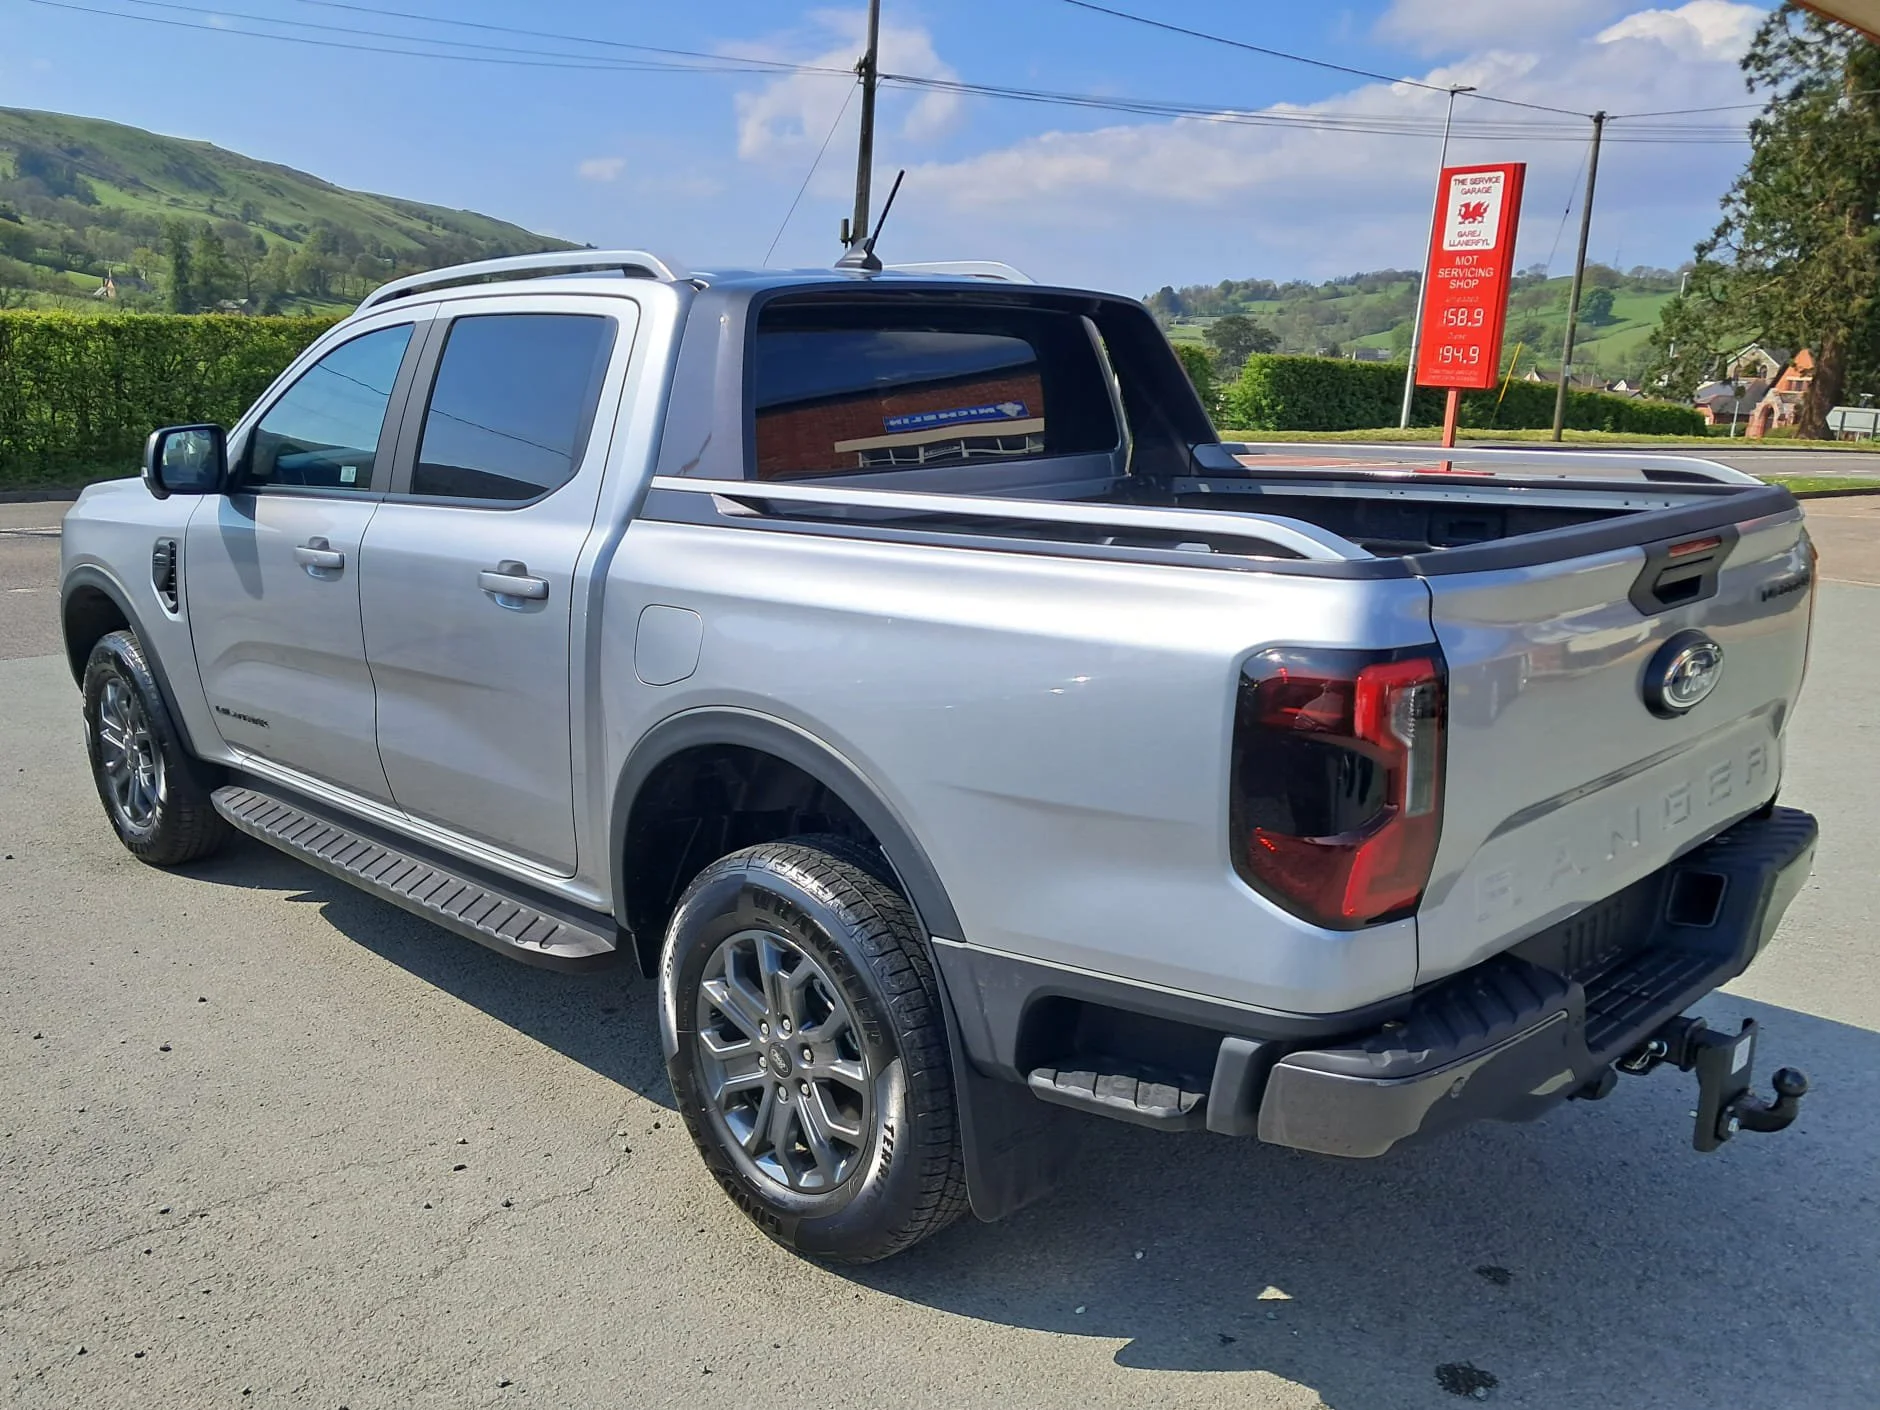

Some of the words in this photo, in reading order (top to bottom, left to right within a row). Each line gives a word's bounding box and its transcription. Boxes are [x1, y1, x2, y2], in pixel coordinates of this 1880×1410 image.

[1453, 178, 1467, 186] THE
[1470, 176, 1501, 185] SERVICE
[1460, 186, 1492, 195] GARAGE
[1457, 230, 1481, 238] GAREJ
[1449, 239, 1490, 247] LLANERFYL
[1455, 255, 1479, 265] MOT
[1438, 267, 1494, 278] SERVICING
[1449, 279, 1479, 289] SHOP
[1443, 307, 1484, 327] 158.9
[1438, 345, 1480, 364] 194.9
[1475, 741, 1768, 923] RANGER
